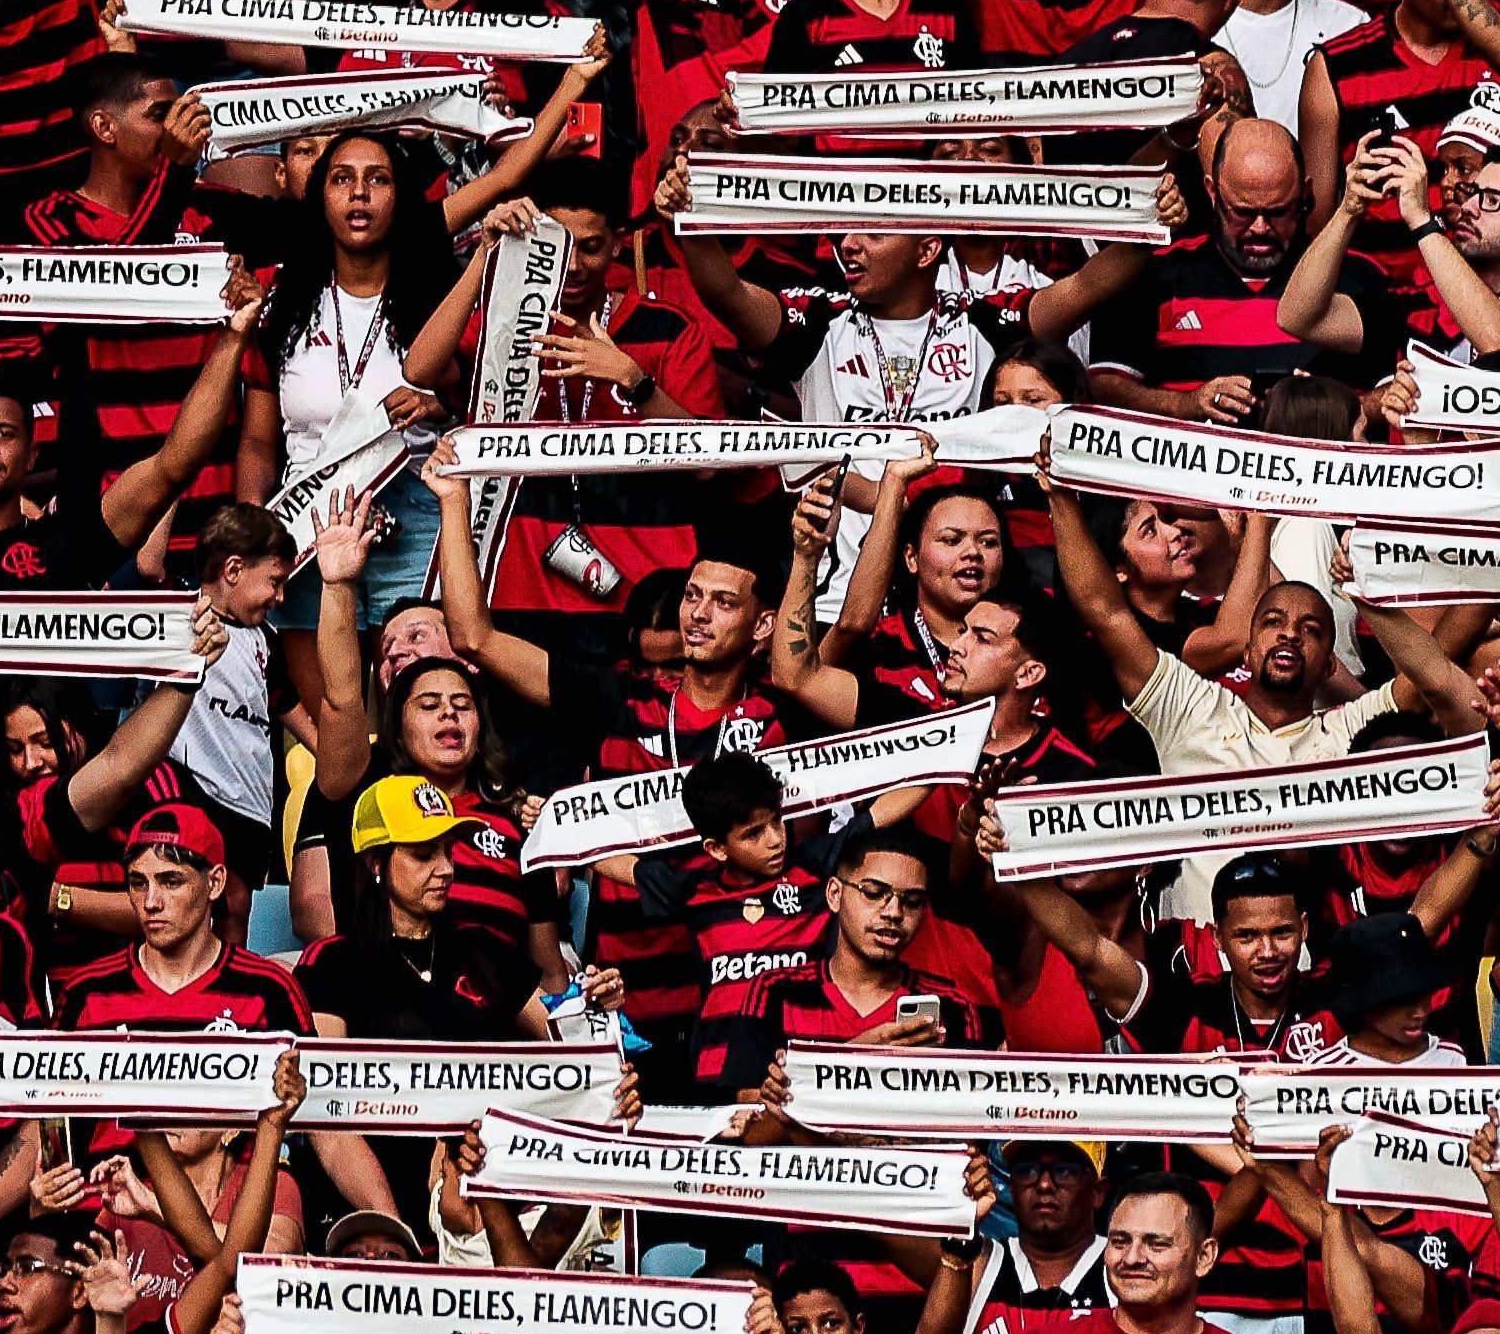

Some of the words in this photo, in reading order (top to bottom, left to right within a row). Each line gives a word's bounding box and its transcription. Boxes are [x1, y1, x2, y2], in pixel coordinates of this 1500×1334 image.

[711, 174, 770, 200] PRA
[779, 180, 855, 202] CIMA
[864, 183, 950, 208] DELES,
[960, 183, 1137, 209] FLAMENGO!
[23, 259, 198, 287] FLAMENGO!
[524, 239, 557, 285] PRA
[508, 293, 547, 361] CIMA
[1068, 423, 1122, 458] PRA
[1132, 436, 1206, 472] CIMA
[1216, 448, 1302, 486] DELES,
[1313, 461, 1483, 489] FLAMENGO!
[1029, 803, 1087, 837] PRA
[1094, 797, 1174, 828] CIMA
[1180, 789, 1271, 820] DELES,
[1279, 763, 1457, 808] FLAMENGO!
[355, 1101, 418, 1115] Betano
[1014, 1107, 1077, 1119] Betano
[277, 1279, 333, 1310] PRA
[342, 1284, 422, 1316] CIMA
[433, 1288, 523, 1326] DELES,
[534, 1293, 716, 1331] FLAMENGO!
